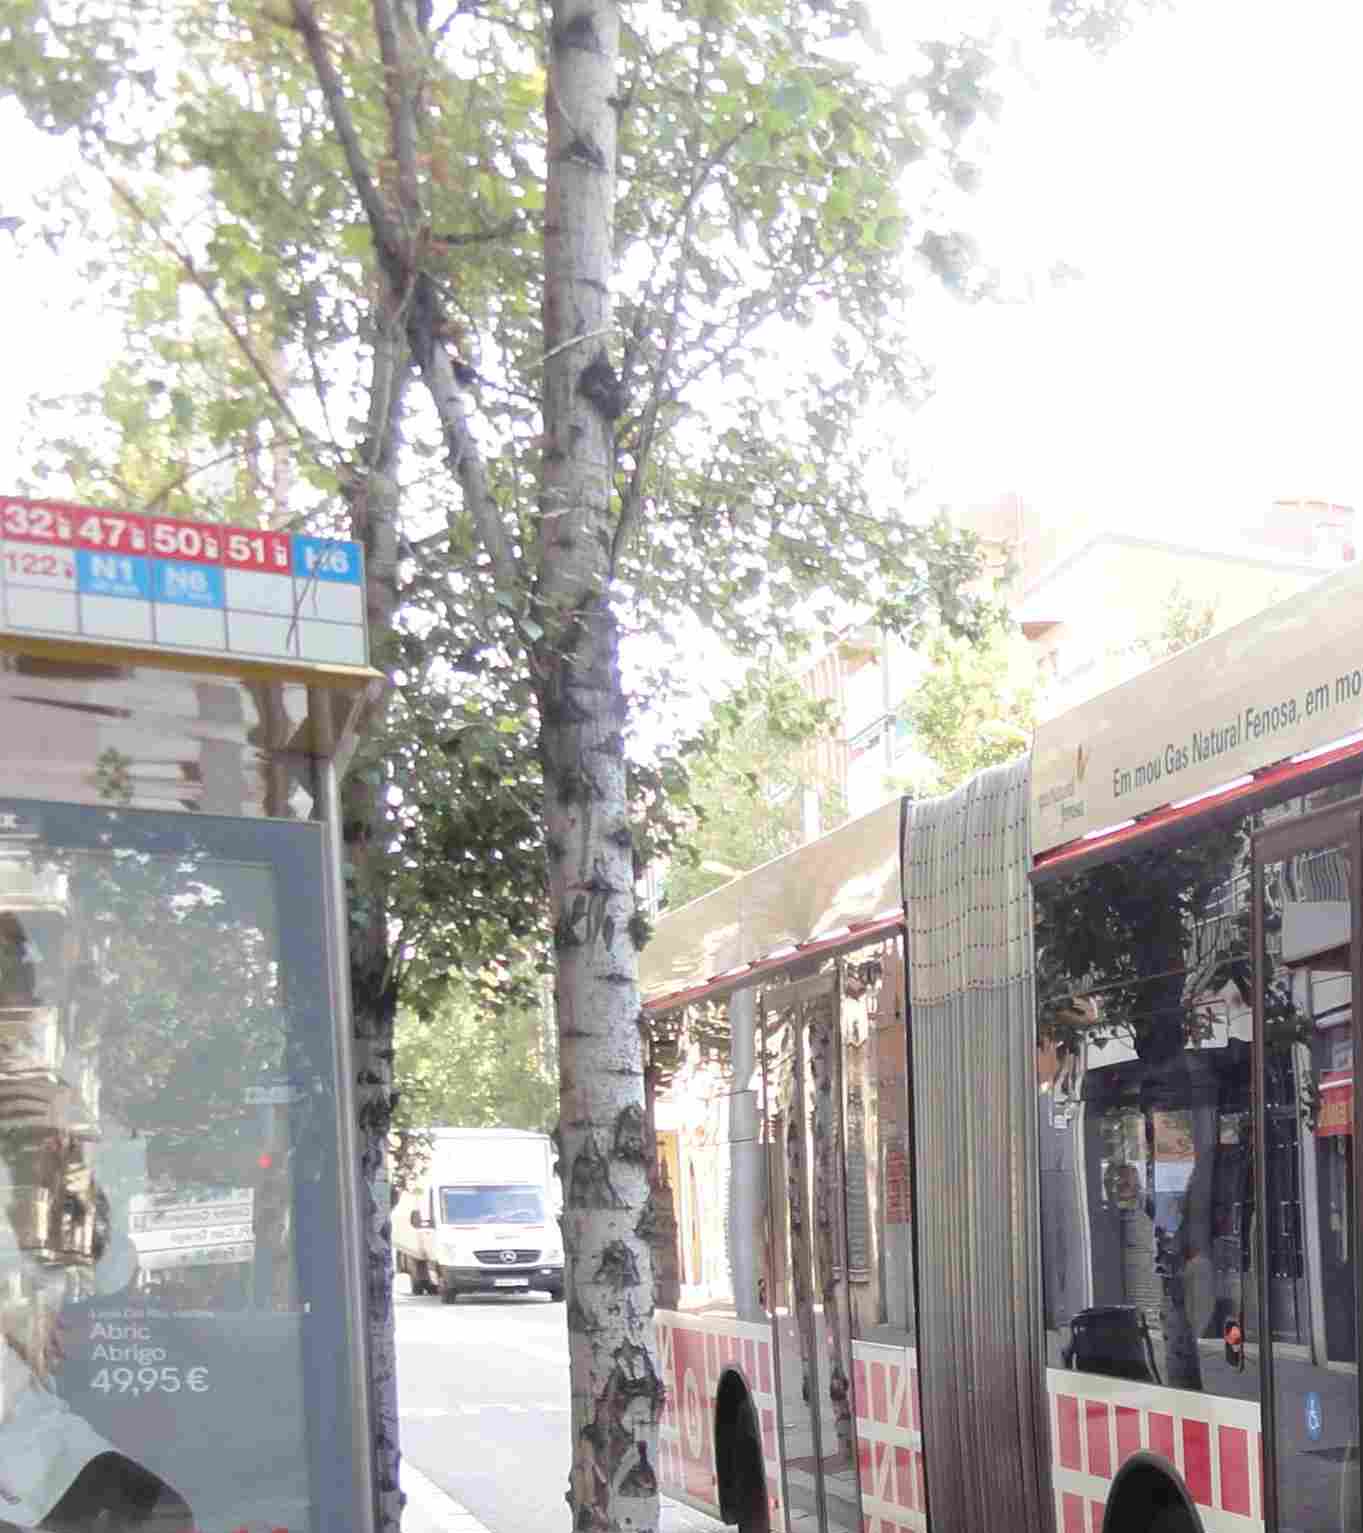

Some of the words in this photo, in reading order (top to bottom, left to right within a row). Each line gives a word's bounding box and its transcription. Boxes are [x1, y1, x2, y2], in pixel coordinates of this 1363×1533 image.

[4, 505, 52, 540] 32
[80, 516, 127, 548] 47
[154, 522, 200, 557] 50
[228, 534, 265, 564] 51
[1111, 768, 1132, 798] Em
[1135, 757, 1162, 790] mou
[1164, 743, 1190, 775] Gas
[1191, 716, 1241, 764] Natural
[1244, 697, 1302, 741] Fenosa,
[1305, 683, 1330, 715] em
[89, 1321, 151, 1341] Abric
[91, 1343, 168, 1367] Abrigo
